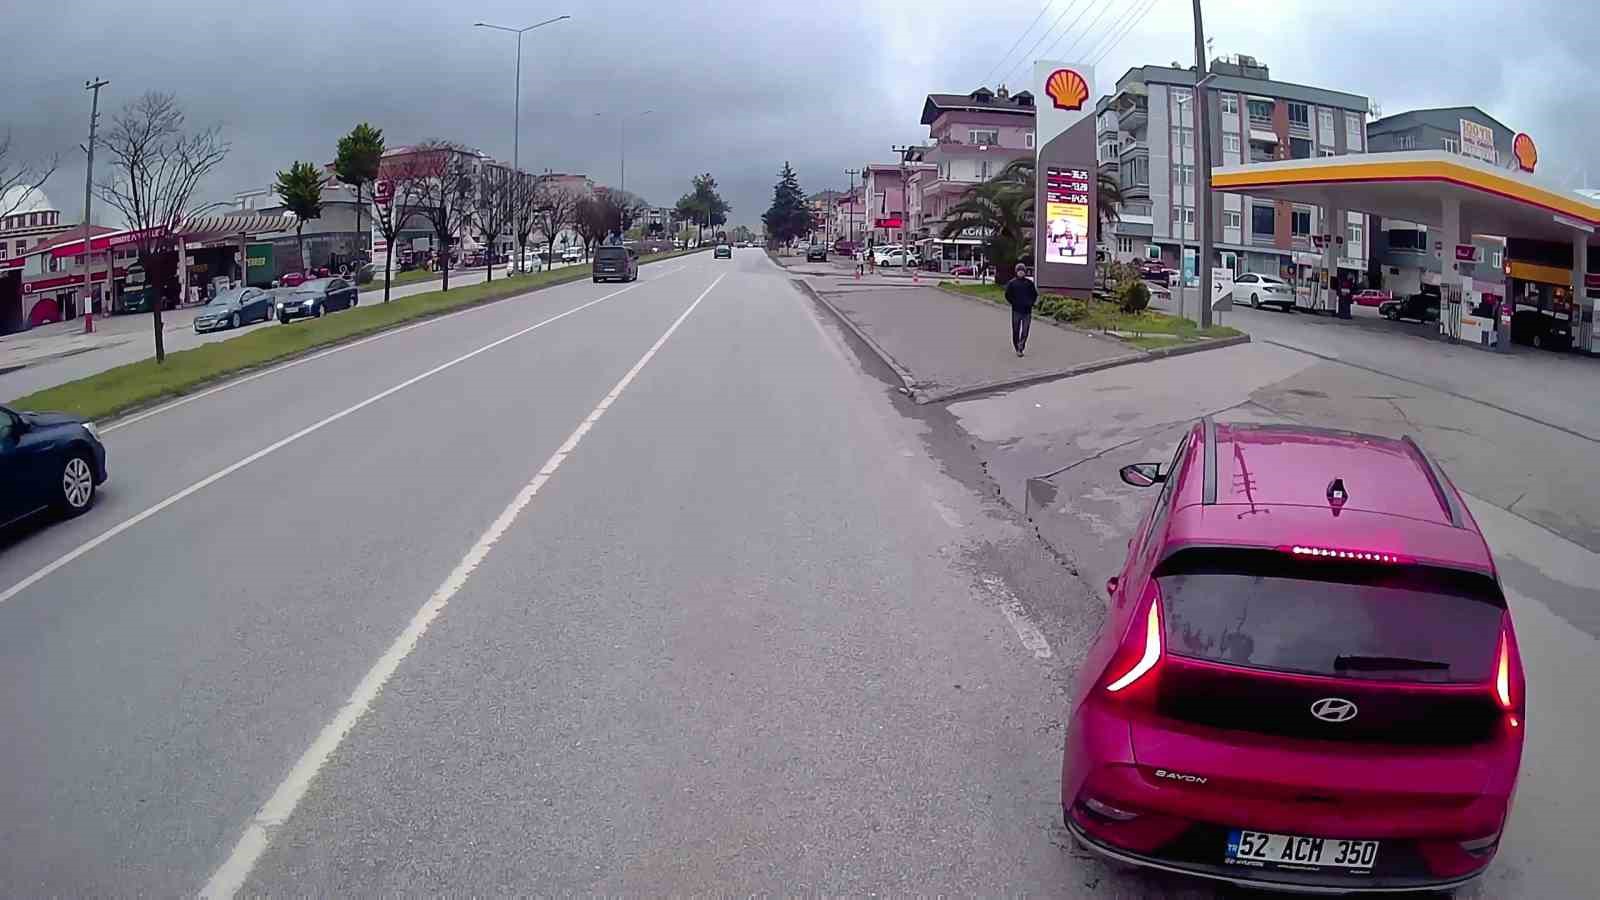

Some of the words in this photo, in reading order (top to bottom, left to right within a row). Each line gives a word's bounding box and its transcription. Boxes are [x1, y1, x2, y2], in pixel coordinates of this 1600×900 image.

[1155, 769, 1208, 784] BAYON
[1239, 832, 1270, 858] 52
[1280, 835, 1325, 863] ACM
[1334, 840, 1377, 866] 350
